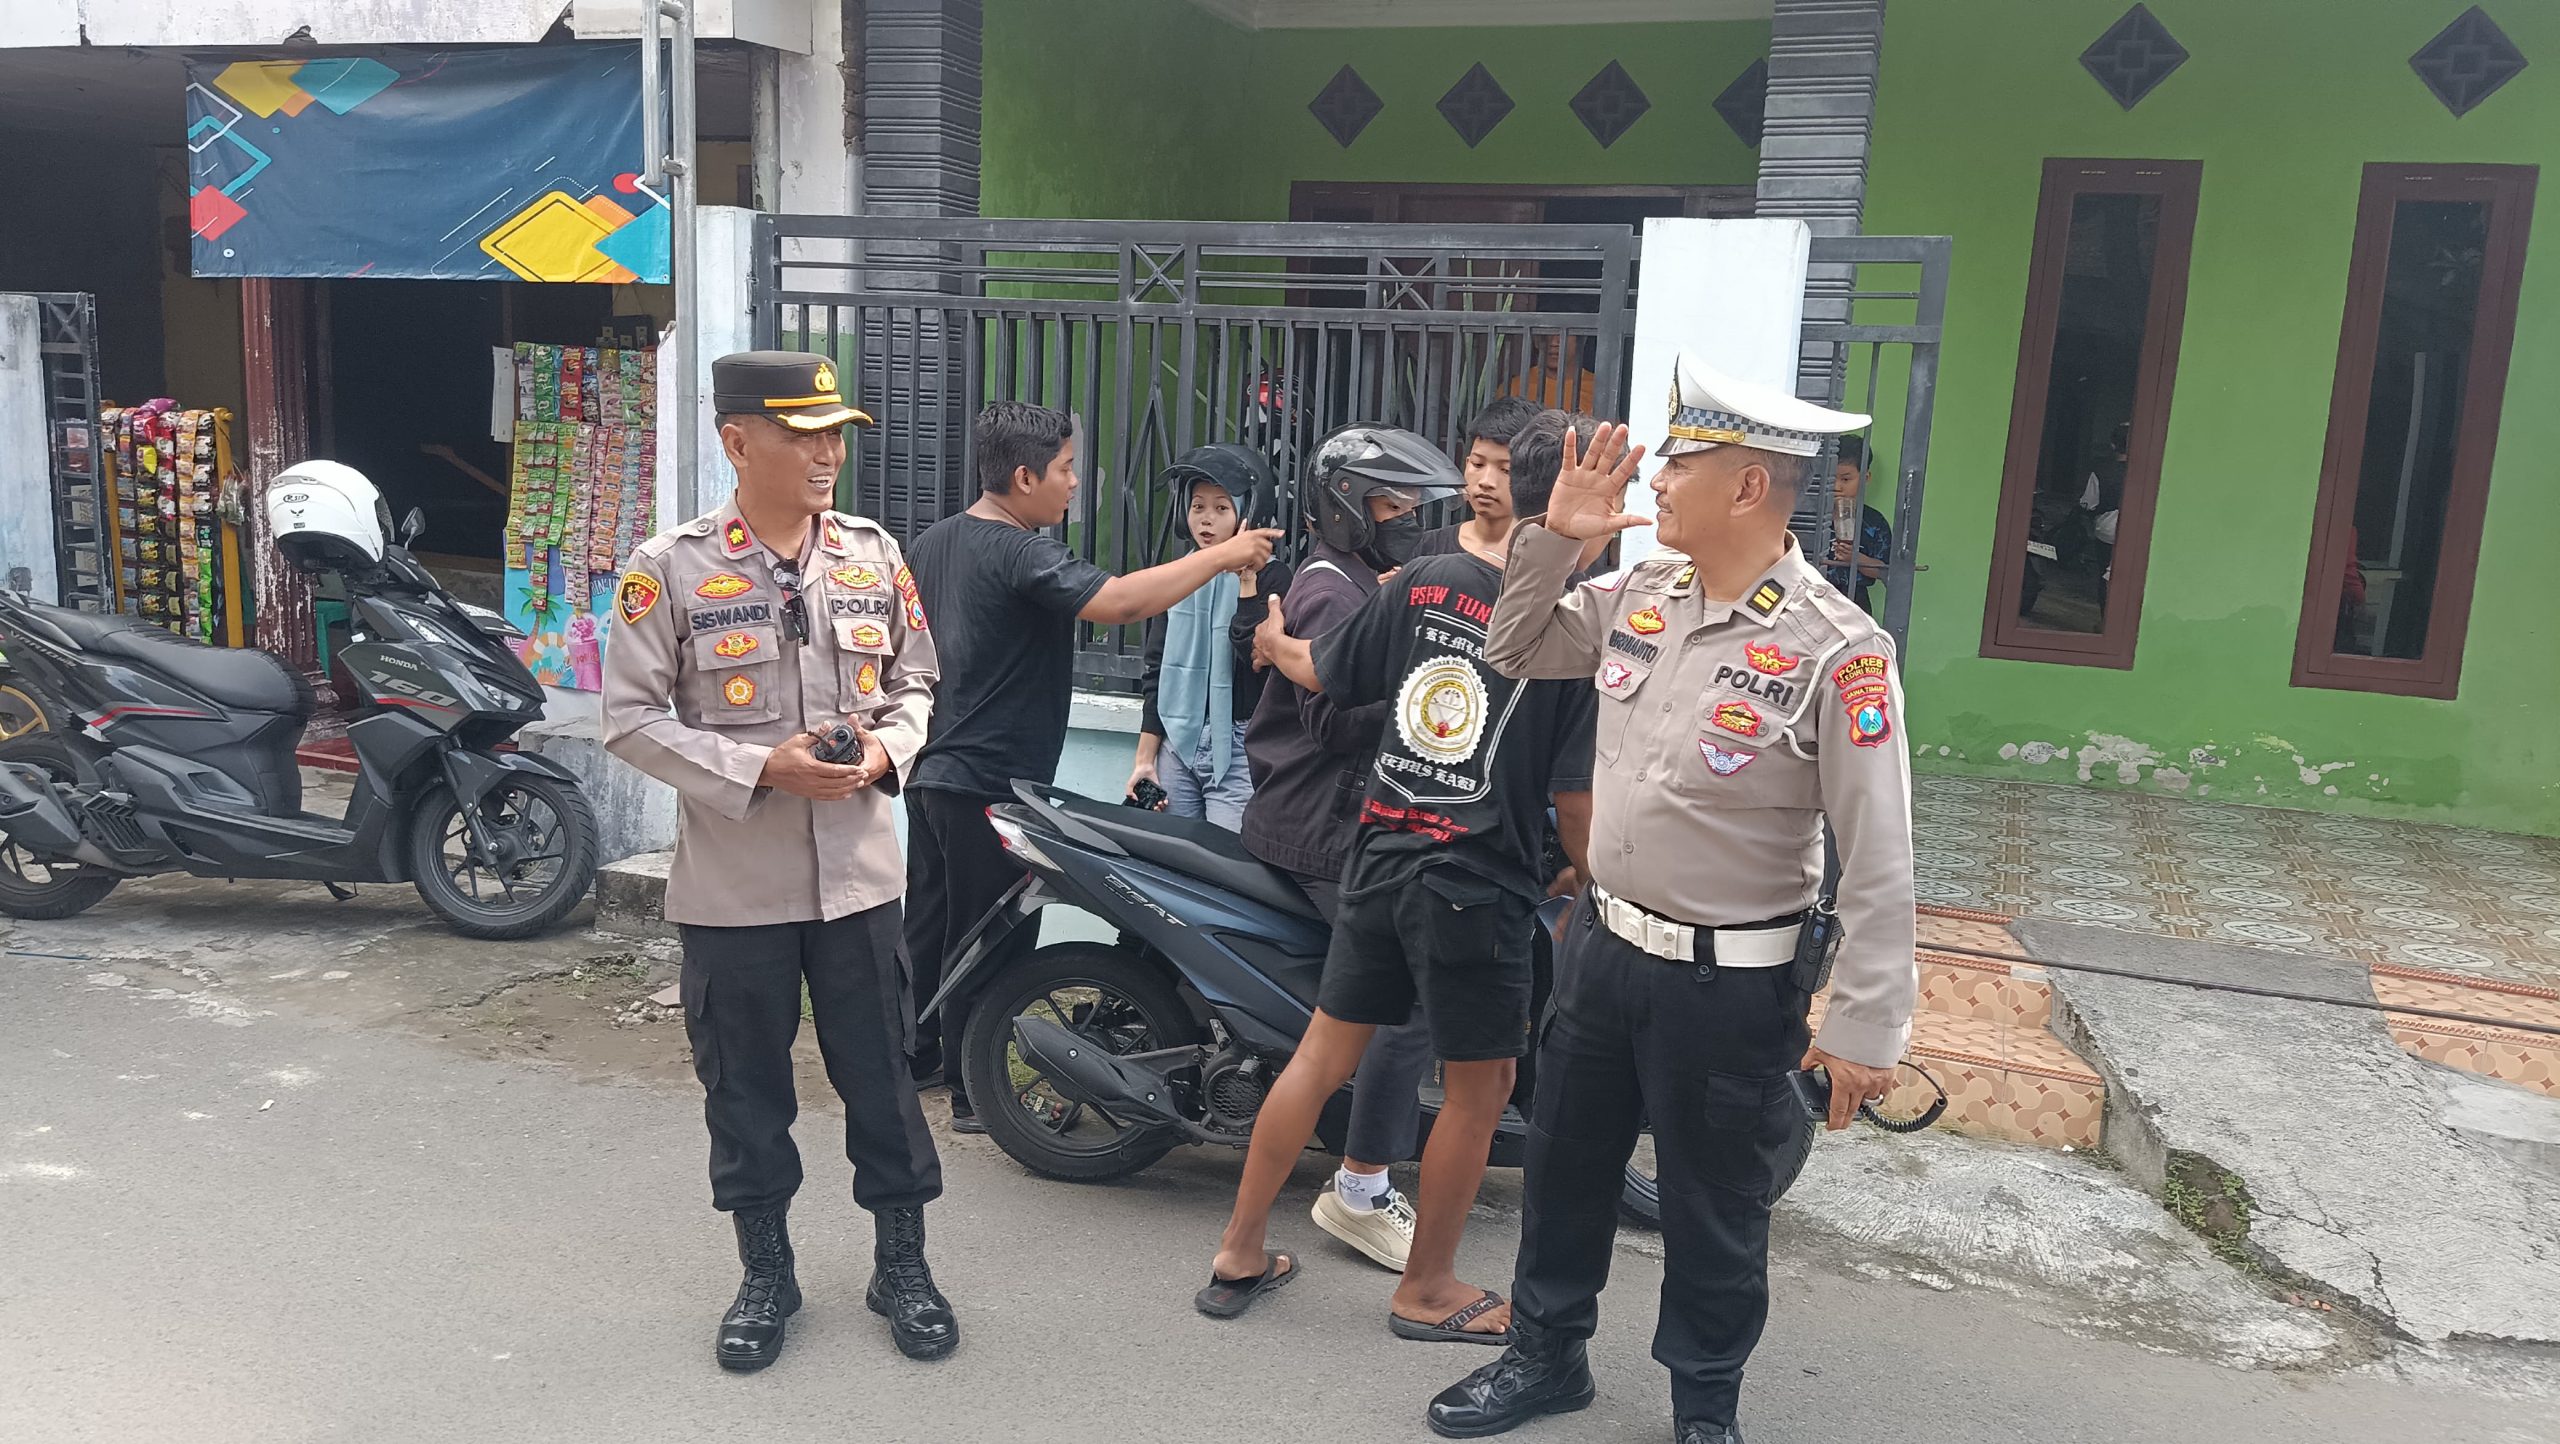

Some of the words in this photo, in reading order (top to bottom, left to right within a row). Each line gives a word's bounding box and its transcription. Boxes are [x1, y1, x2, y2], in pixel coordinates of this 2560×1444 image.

[691, 603, 770, 630] SISWANDI
[831, 598, 890, 616] POLRI
[380, 654, 418, 671] HONDA
[1838, 657, 1884, 678] POLRES
[1840, 668, 1864, 685] KEDIRI
[1865, 666, 1883, 675] KOTA
[369, 669, 458, 707] 160
[1714, 665, 1793, 707] POLRI
[1846, 688, 1865, 698] JAWA
